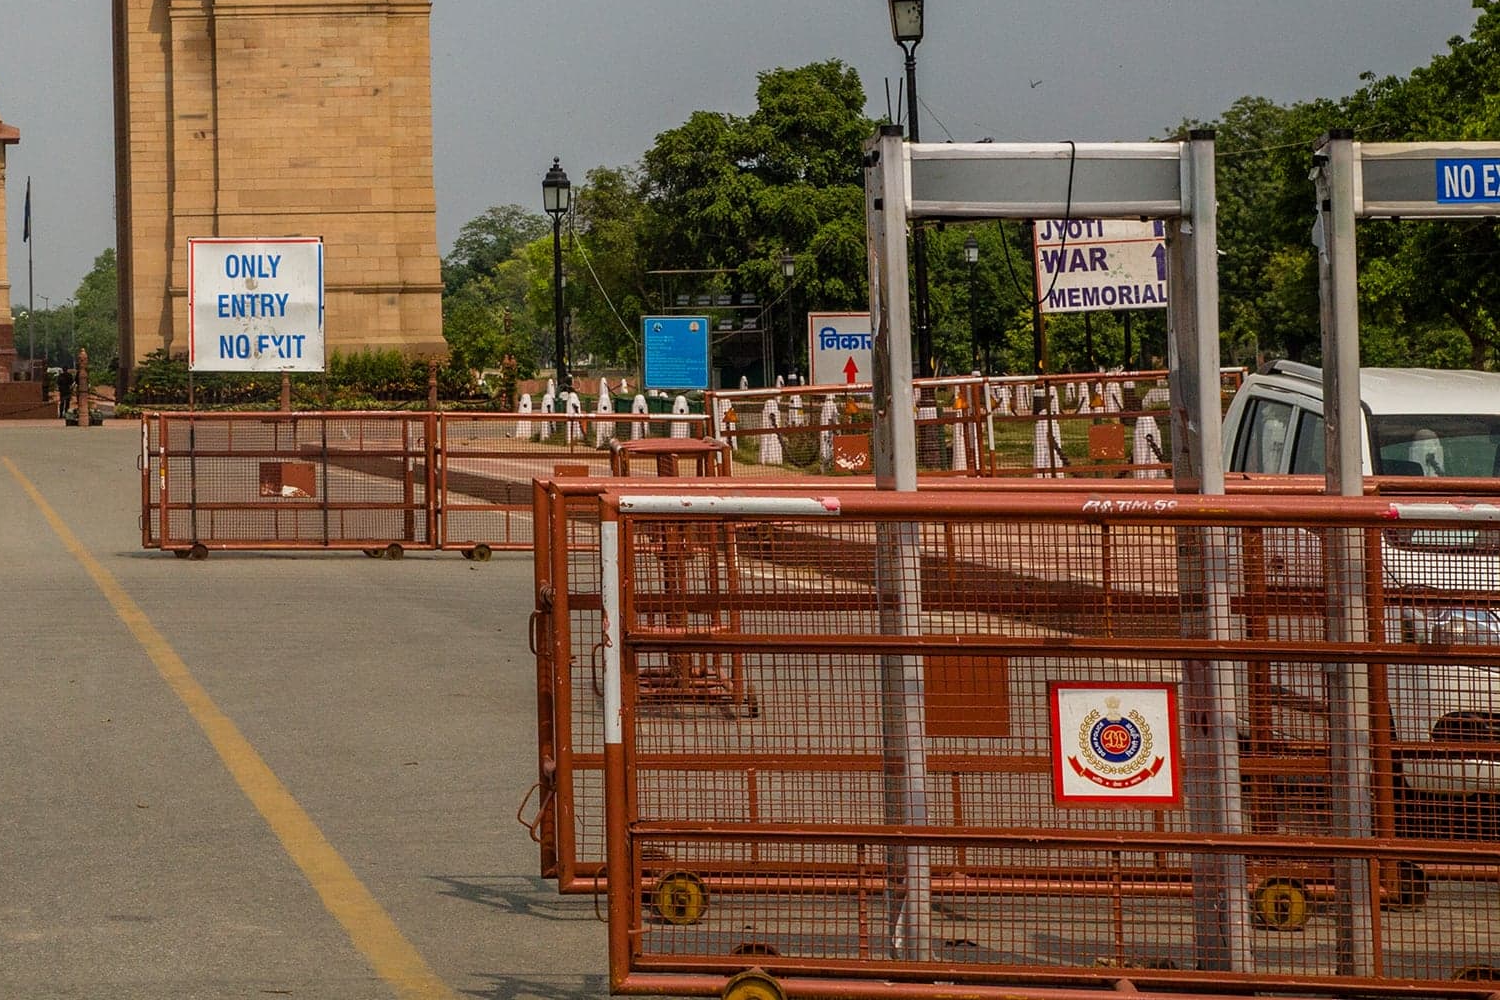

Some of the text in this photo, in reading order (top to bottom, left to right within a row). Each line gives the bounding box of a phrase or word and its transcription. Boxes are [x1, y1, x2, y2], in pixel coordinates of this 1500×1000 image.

[1444, 164, 1475, 198] NO
[1041, 219, 1103, 240] JYOTI
[226, 255, 281, 278] ONLY
[1042, 247, 1109, 273] WAR
[218, 293, 289, 318] ENTRY
[1049, 284, 1167, 308] MEMORIAL
[220, 335, 305, 359] NO EXIT
